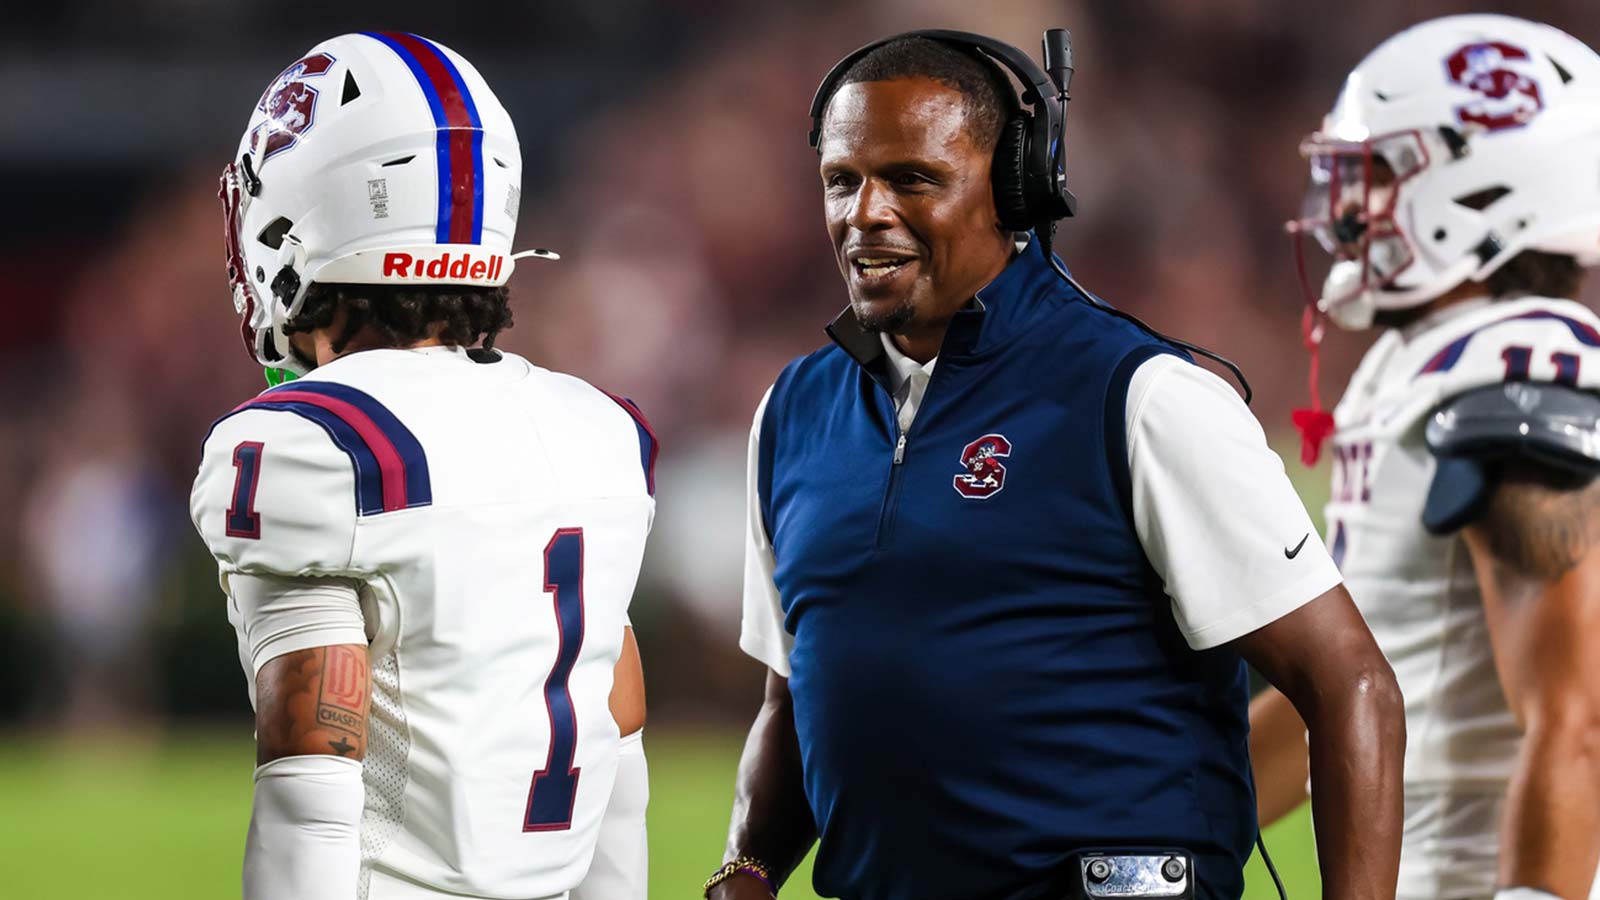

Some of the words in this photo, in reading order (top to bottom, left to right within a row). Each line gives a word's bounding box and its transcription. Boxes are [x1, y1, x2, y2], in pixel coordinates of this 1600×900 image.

[383, 252, 503, 281] Riddell
[225, 440, 265, 540] 1
[522, 526, 584, 833] 1
